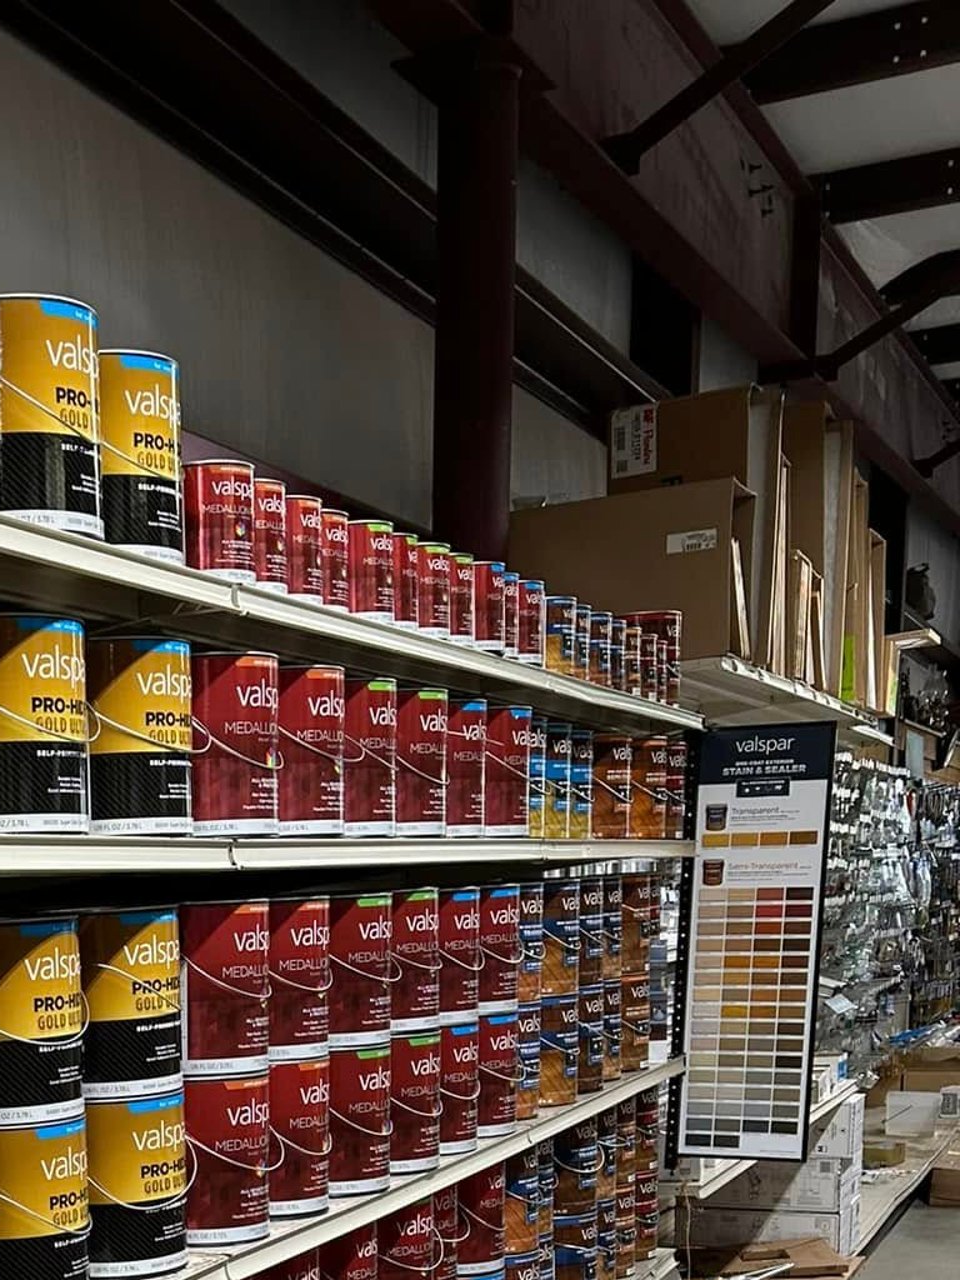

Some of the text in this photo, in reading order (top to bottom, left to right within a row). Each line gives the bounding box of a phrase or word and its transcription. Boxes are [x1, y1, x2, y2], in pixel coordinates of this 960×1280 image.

[137, 450, 166, 468] GOLD
[237, 678, 278, 714] valsp
[735, 734, 796, 755] valspar
[722, 767, 754, 776] STAIN
[764, 764, 807, 775] SEALER
[37, 1015, 66, 1031] GOLD
